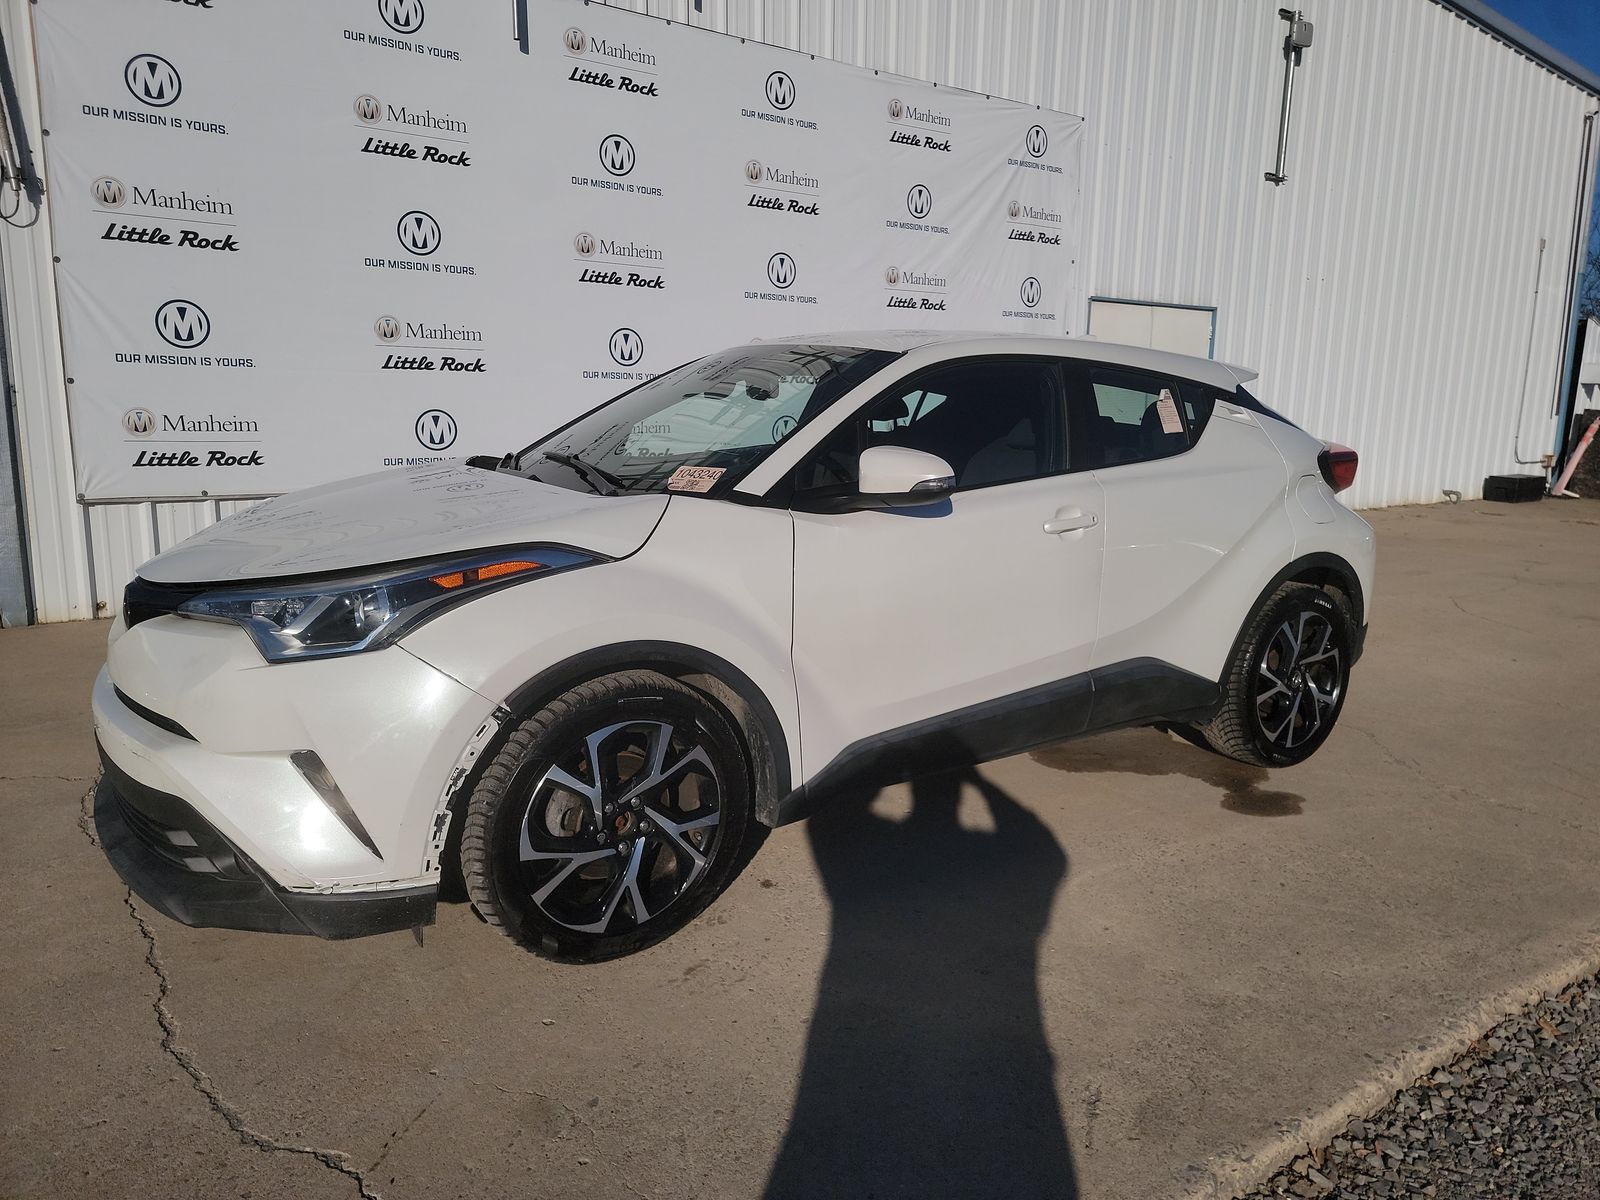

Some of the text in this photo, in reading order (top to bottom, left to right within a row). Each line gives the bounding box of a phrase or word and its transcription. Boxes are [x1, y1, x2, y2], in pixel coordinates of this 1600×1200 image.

[343, 29, 462, 62] OUR MISSION IS YOURS.
[590, 36, 656, 66] Manheim
[568, 66, 659, 97] Little Rock
[82, 104, 229, 135] OUR MISSION IS YOURS.
[386, 104, 468, 133] Manheim
[741, 108, 756, 118] OUR
[757, 112, 786, 124] MISSION
[787, 117, 794, 126] IS
[905, 105, 951, 127] Manheim
[889, 130, 952, 152] Little Rock
[360, 137, 472, 167] Little Rock
[571, 176, 664, 197] OUR MISSION IS YOURS.
[765, 167, 819, 188] Manheim
[132, 186, 234, 215] Manheim
[747, 194, 820, 216] Little Rock
[1022, 206, 1061, 223] Manheim
[100, 222, 240, 252] Little Rock
[1008, 228, 1062, 246] Little Rock
[599, 239, 663, 260] Manheim
[364, 258, 477, 276] OUR MISSION IS YOURS.
[578, 268, 665, 289] Little Rock
[902, 271, 946, 287] Manheim
[744, 291, 758, 299] OUR
[759, 292, 787, 302] MISSION
[886, 296, 947, 311] Little Rock
[405, 322, 483, 341] Manheim
[115, 353, 256, 368] OUR MISSION IS YOURS.
[381, 354, 487, 373] Little Rock
[582, 371, 599, 379] OUR
[601, 371, 634, 380] MISSION
[162, 414, 259, 432] Manheim
[132, 450, 265, 467] Little Rock
[383, 458, 403, 466] OUR
[676, 468, 723, 480] 1043240
